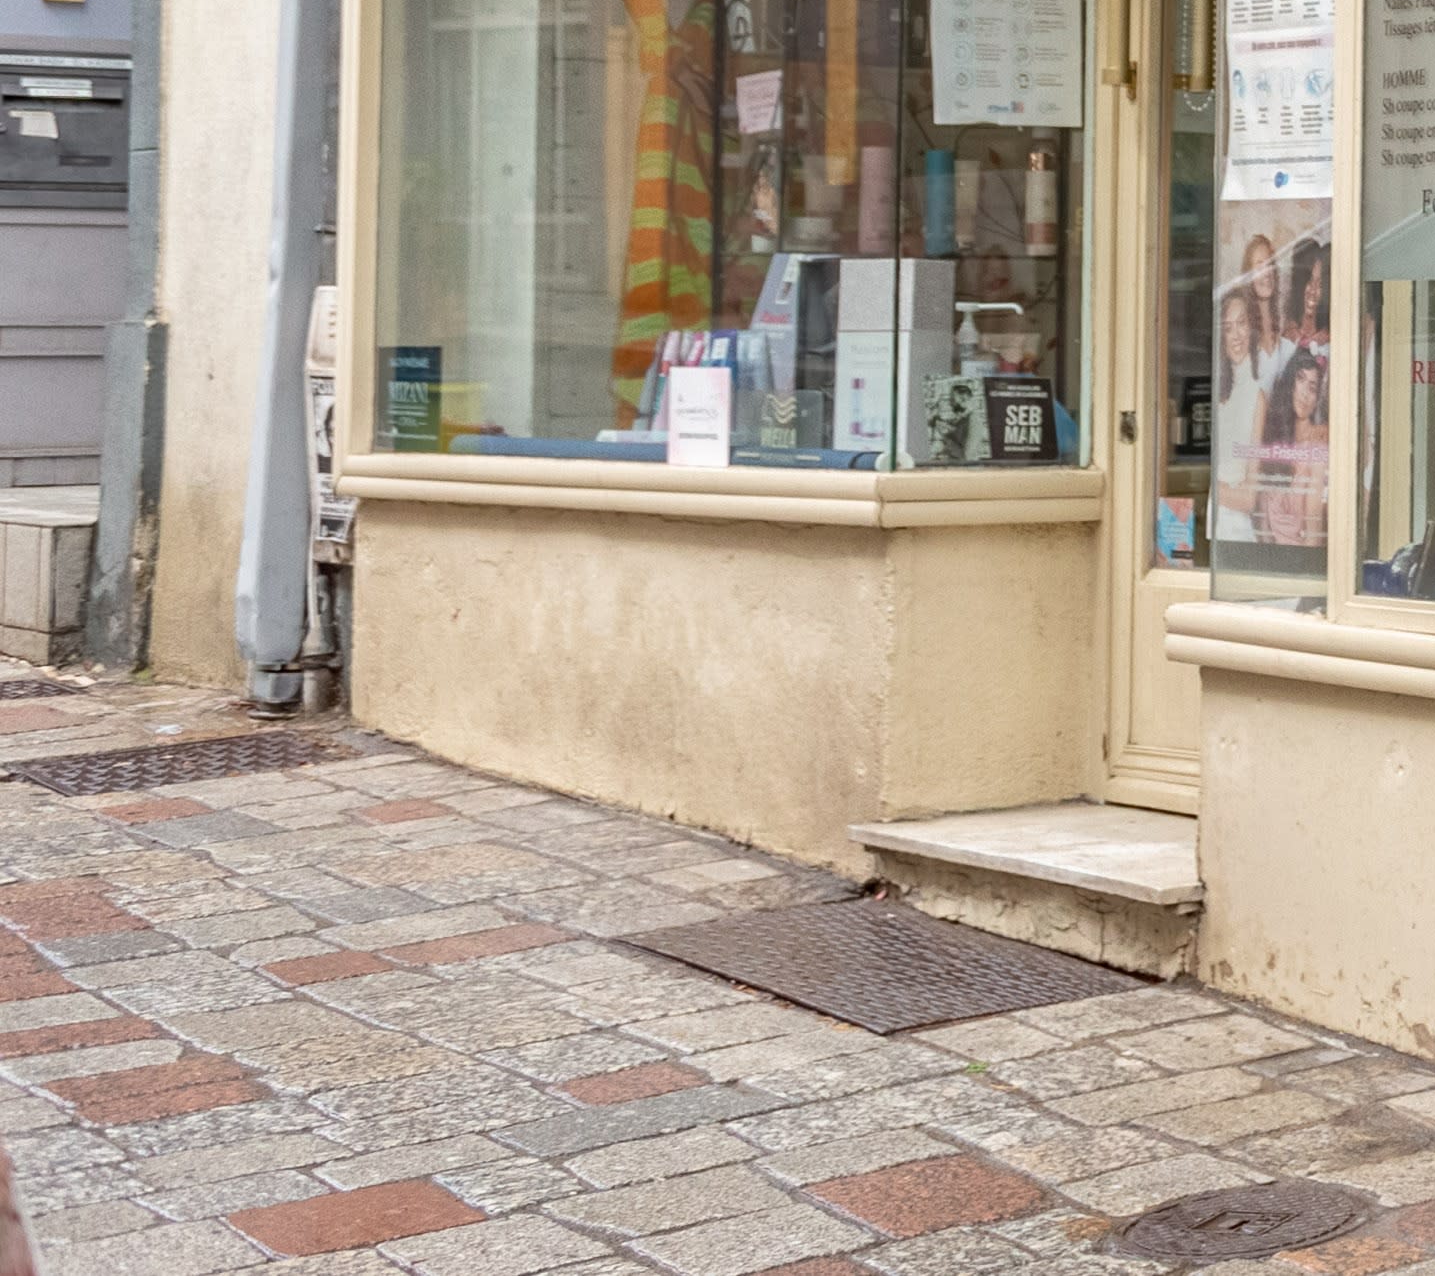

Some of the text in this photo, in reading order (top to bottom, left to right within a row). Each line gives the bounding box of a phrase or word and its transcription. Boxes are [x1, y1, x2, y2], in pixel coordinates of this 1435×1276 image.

[1383, 18, 1422, 40] Tissages
[1382, 68, 1426, 89] HOMME
[1396, 97, 1424, 116] coupe
[1396, 124, 1424, 143] coupe
[1396, 150, 1424, 168] coupe
[1005, 404, 1043, 427] SEB
[1003, 426, 1042, 447] MAN
